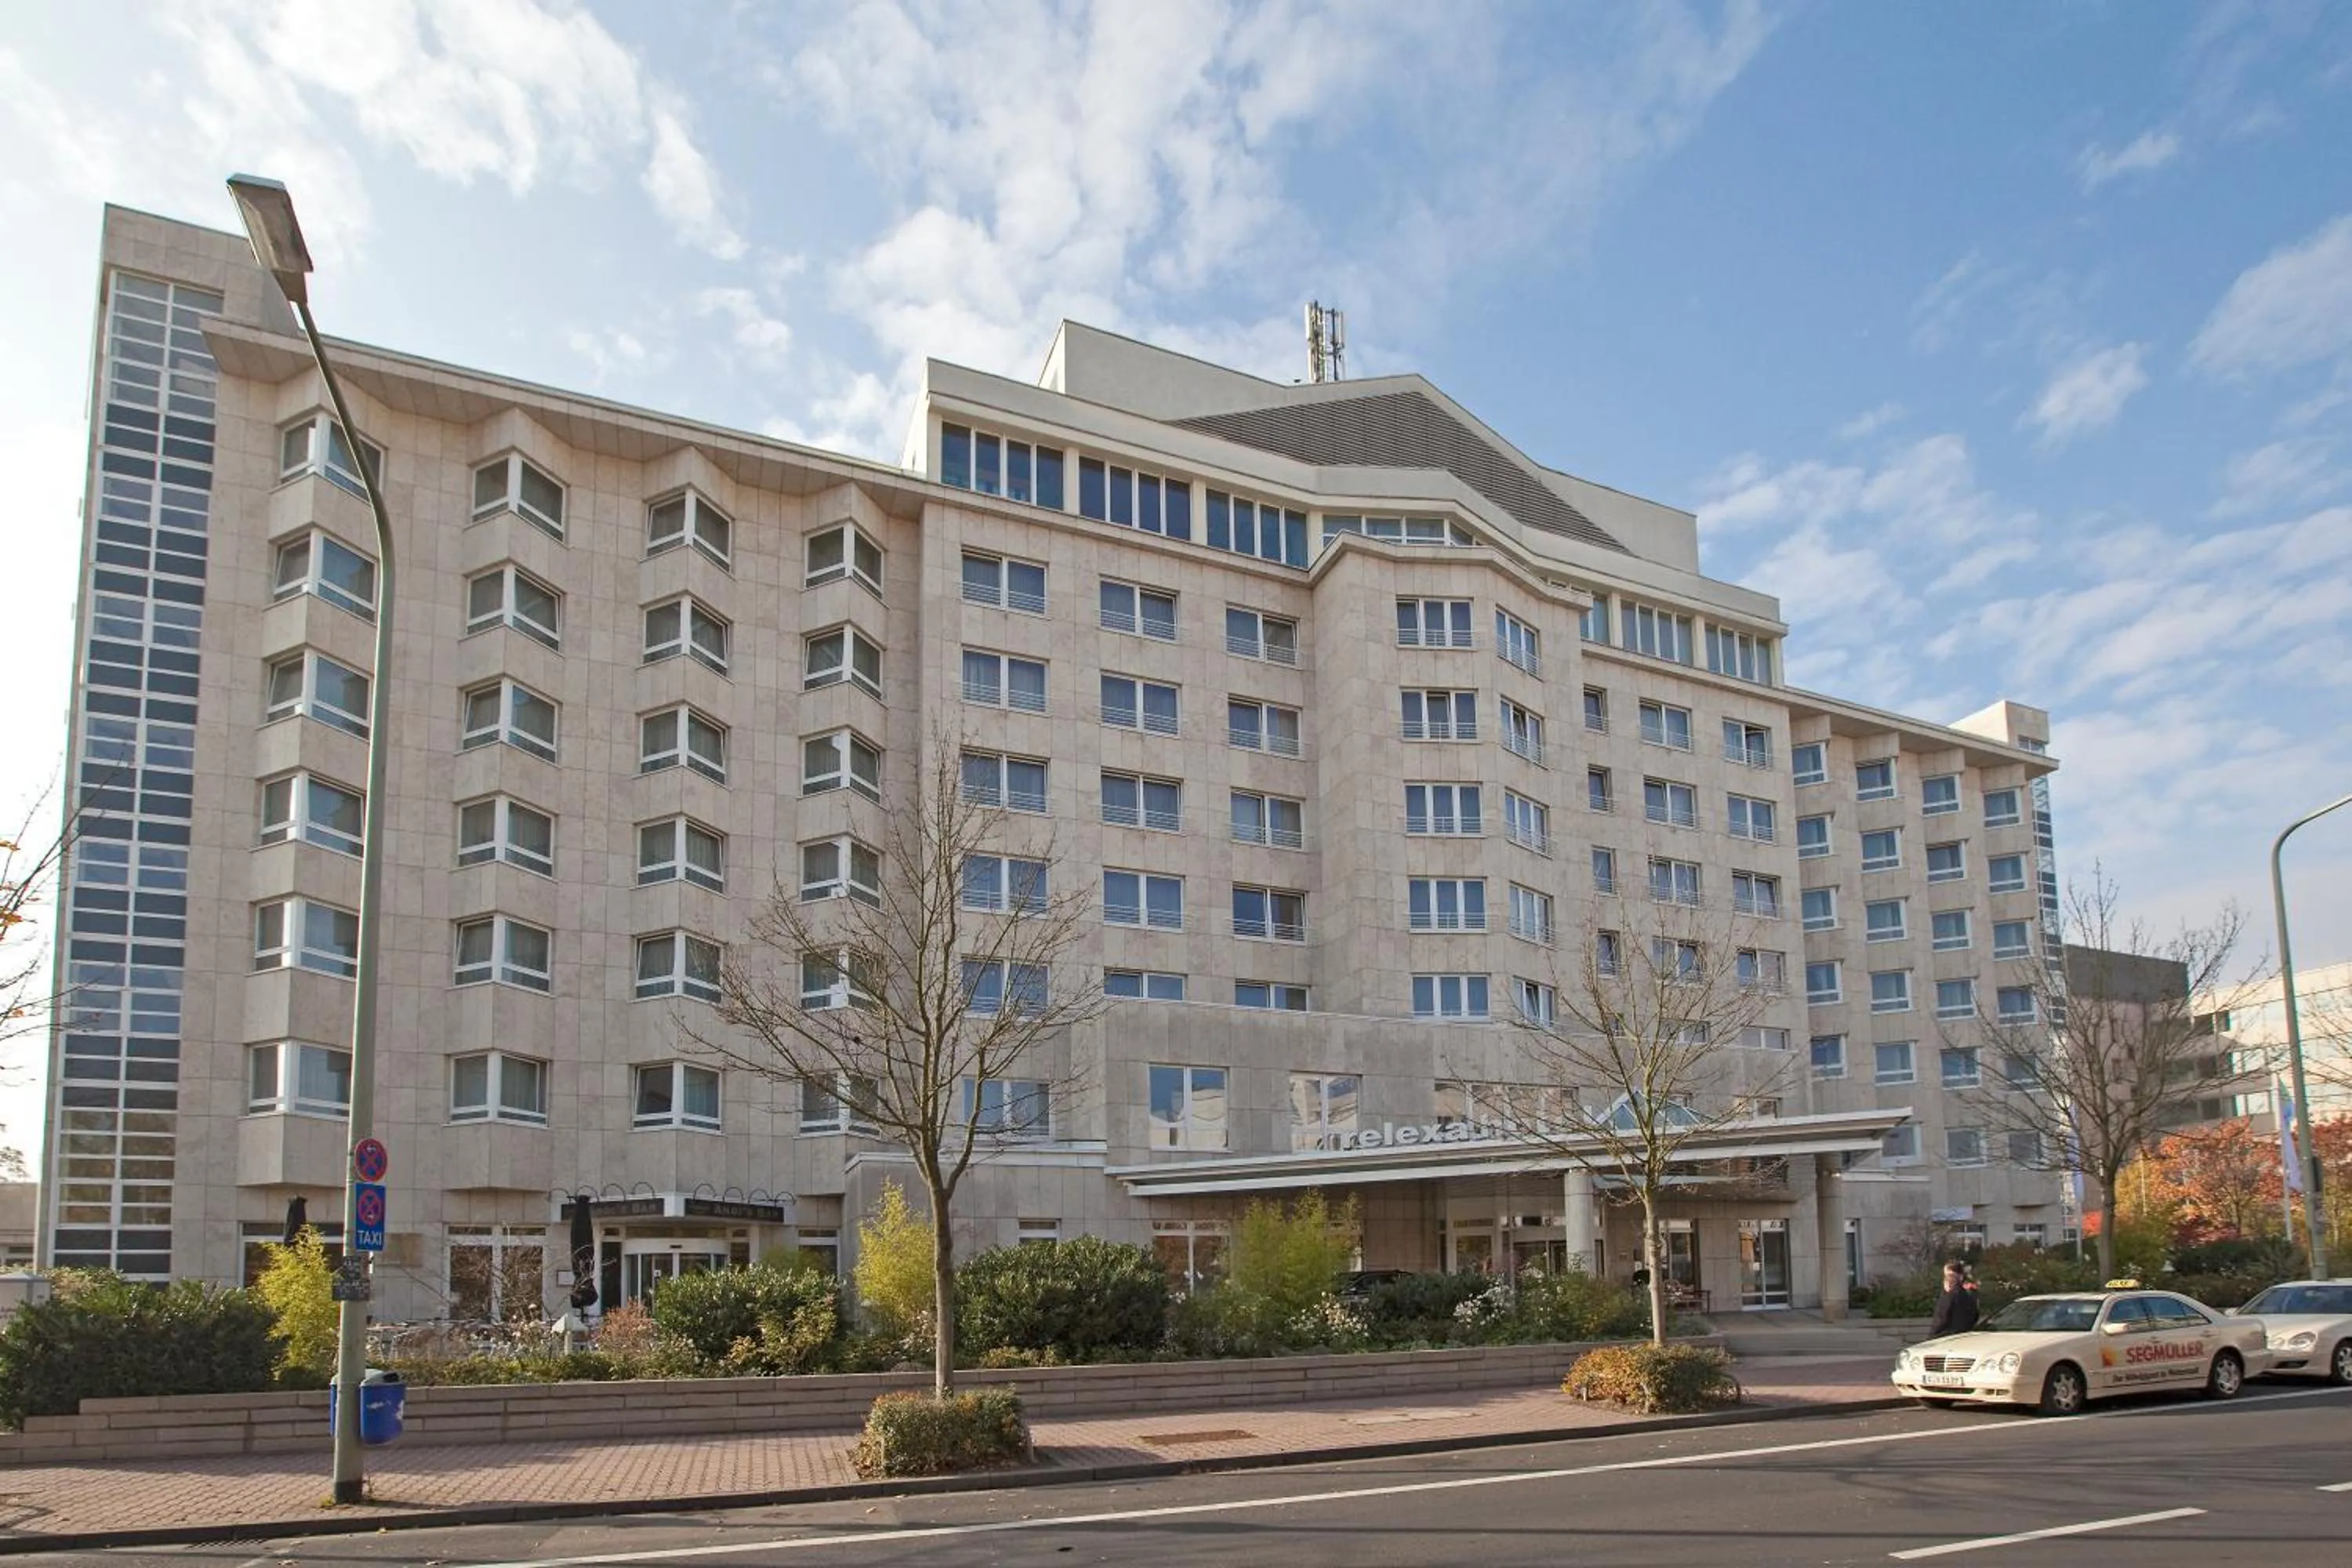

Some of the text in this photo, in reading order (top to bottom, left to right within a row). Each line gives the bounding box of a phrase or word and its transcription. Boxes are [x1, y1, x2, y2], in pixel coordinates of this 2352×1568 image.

[1341, 1122, 1469, 1149] relexa
[358, 1230, 383, 1246] TAXI
[2125, 1341, 2205, 1363] SEGMÜLLER
